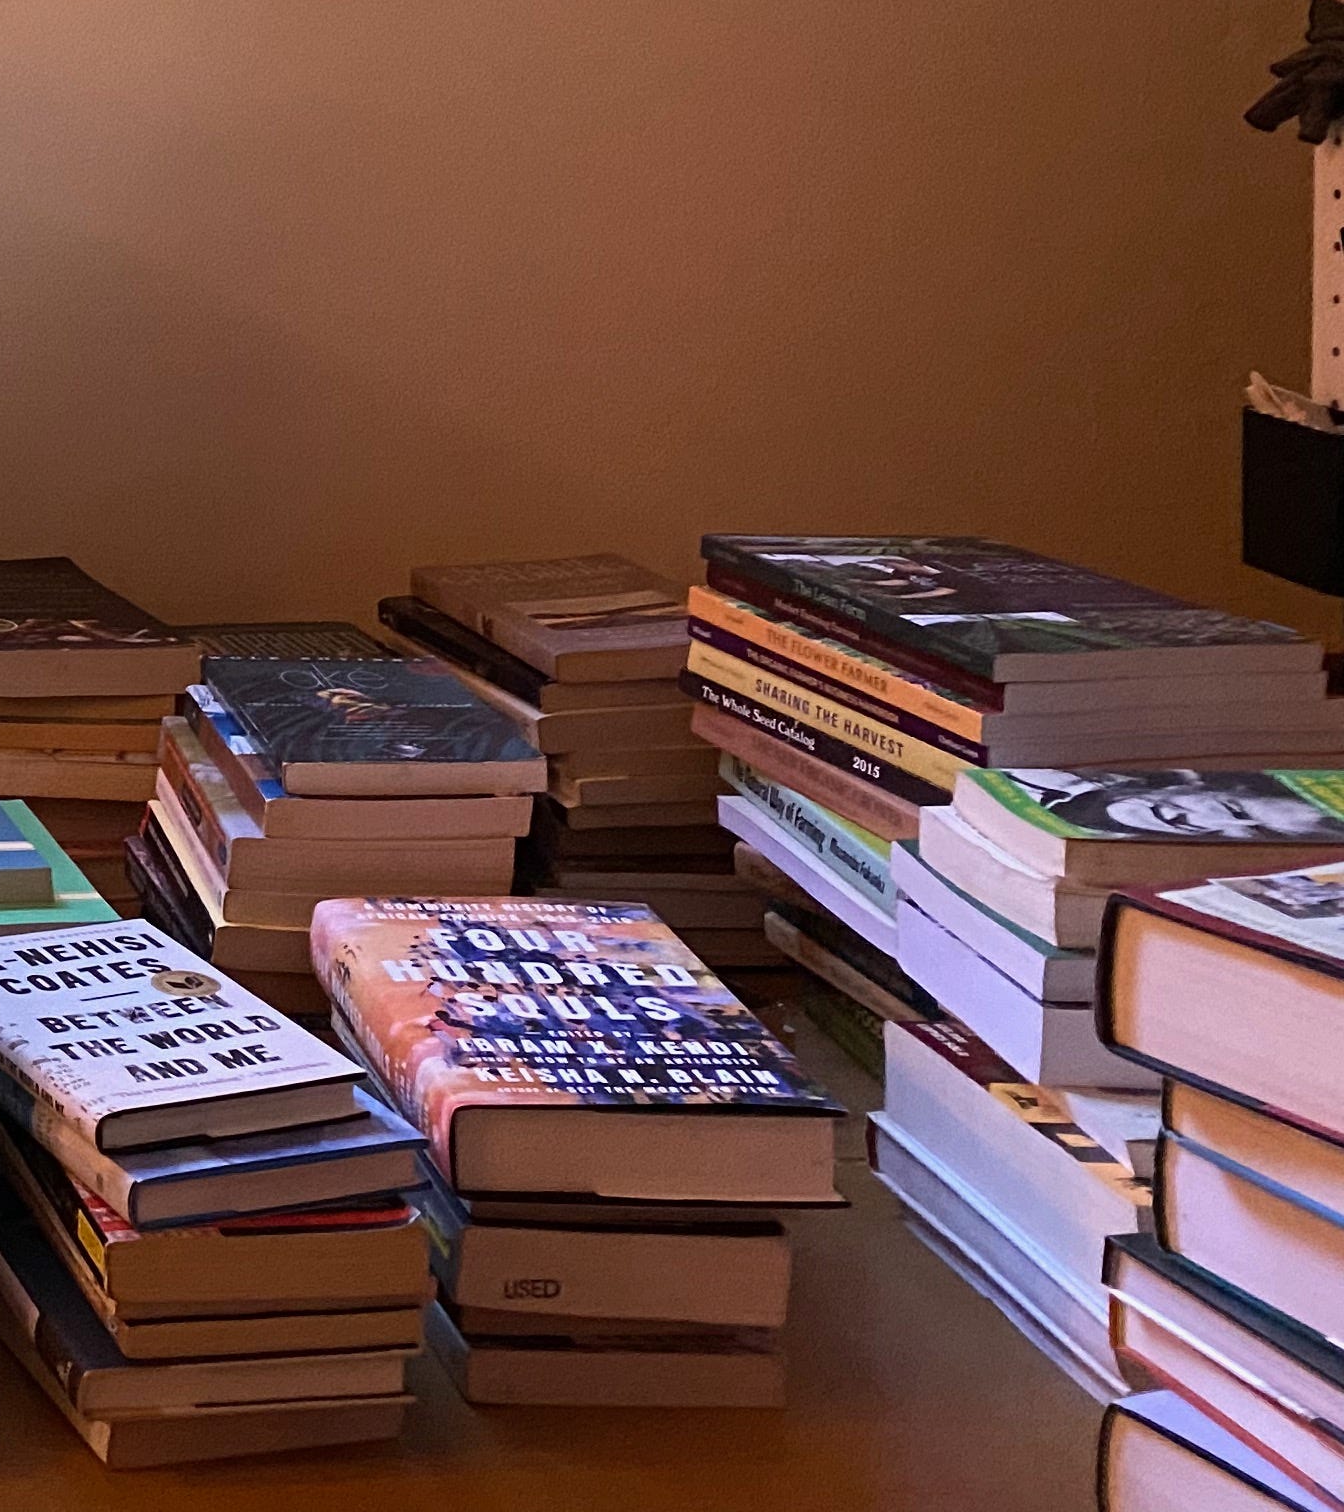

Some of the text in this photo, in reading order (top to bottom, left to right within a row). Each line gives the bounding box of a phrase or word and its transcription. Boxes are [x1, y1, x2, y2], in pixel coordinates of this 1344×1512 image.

[702, 685, 815, 750] The Whole Seed Catalog
[756, 679, 810, 714] SHARING
[816, 705, 838, 727] THE
[844, 719, 904, 758] HARVEST
[853, 756, 880, 779] 2015
[428, 928, 599, 952] FOUR
[381, 960, 699, 987] HUNDRED
[37, 995, 233, 1034] BETWEEN
[453, 992, 683, 1021] SOULS
[50, 1015, 281, 1060] THE WORLD
[645, 1041, 748, 1055] KENDI
[125, 1045, 281, 1083] AND ME
[476, 1068, 780, 1084] KEISHA N. BLAIN
[504, 1279, 561, 1299] USED
